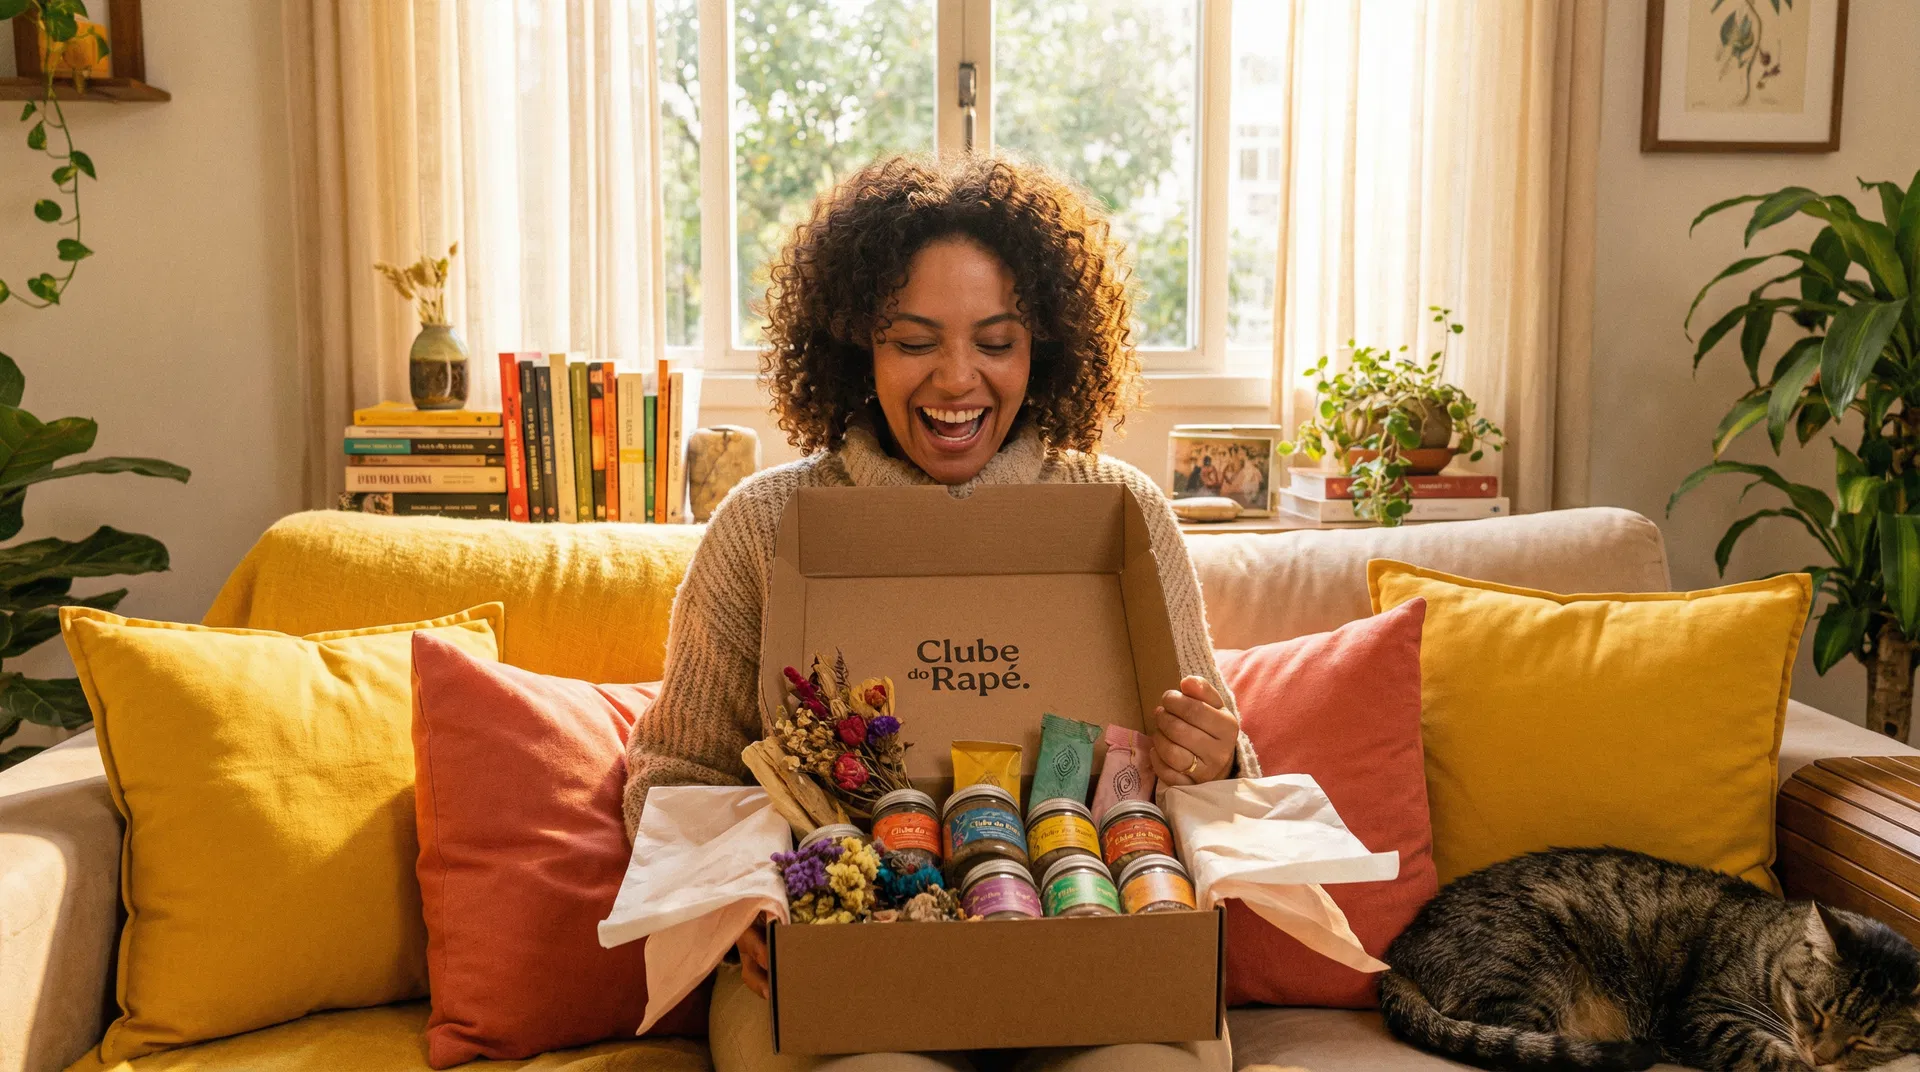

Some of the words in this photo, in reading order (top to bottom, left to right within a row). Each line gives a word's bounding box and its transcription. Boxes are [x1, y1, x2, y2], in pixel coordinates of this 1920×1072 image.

[917, 639, 1020, 664] Clube
[908, 667, 930, 680] do
[931, 664, 1031, 697] Rapé.
